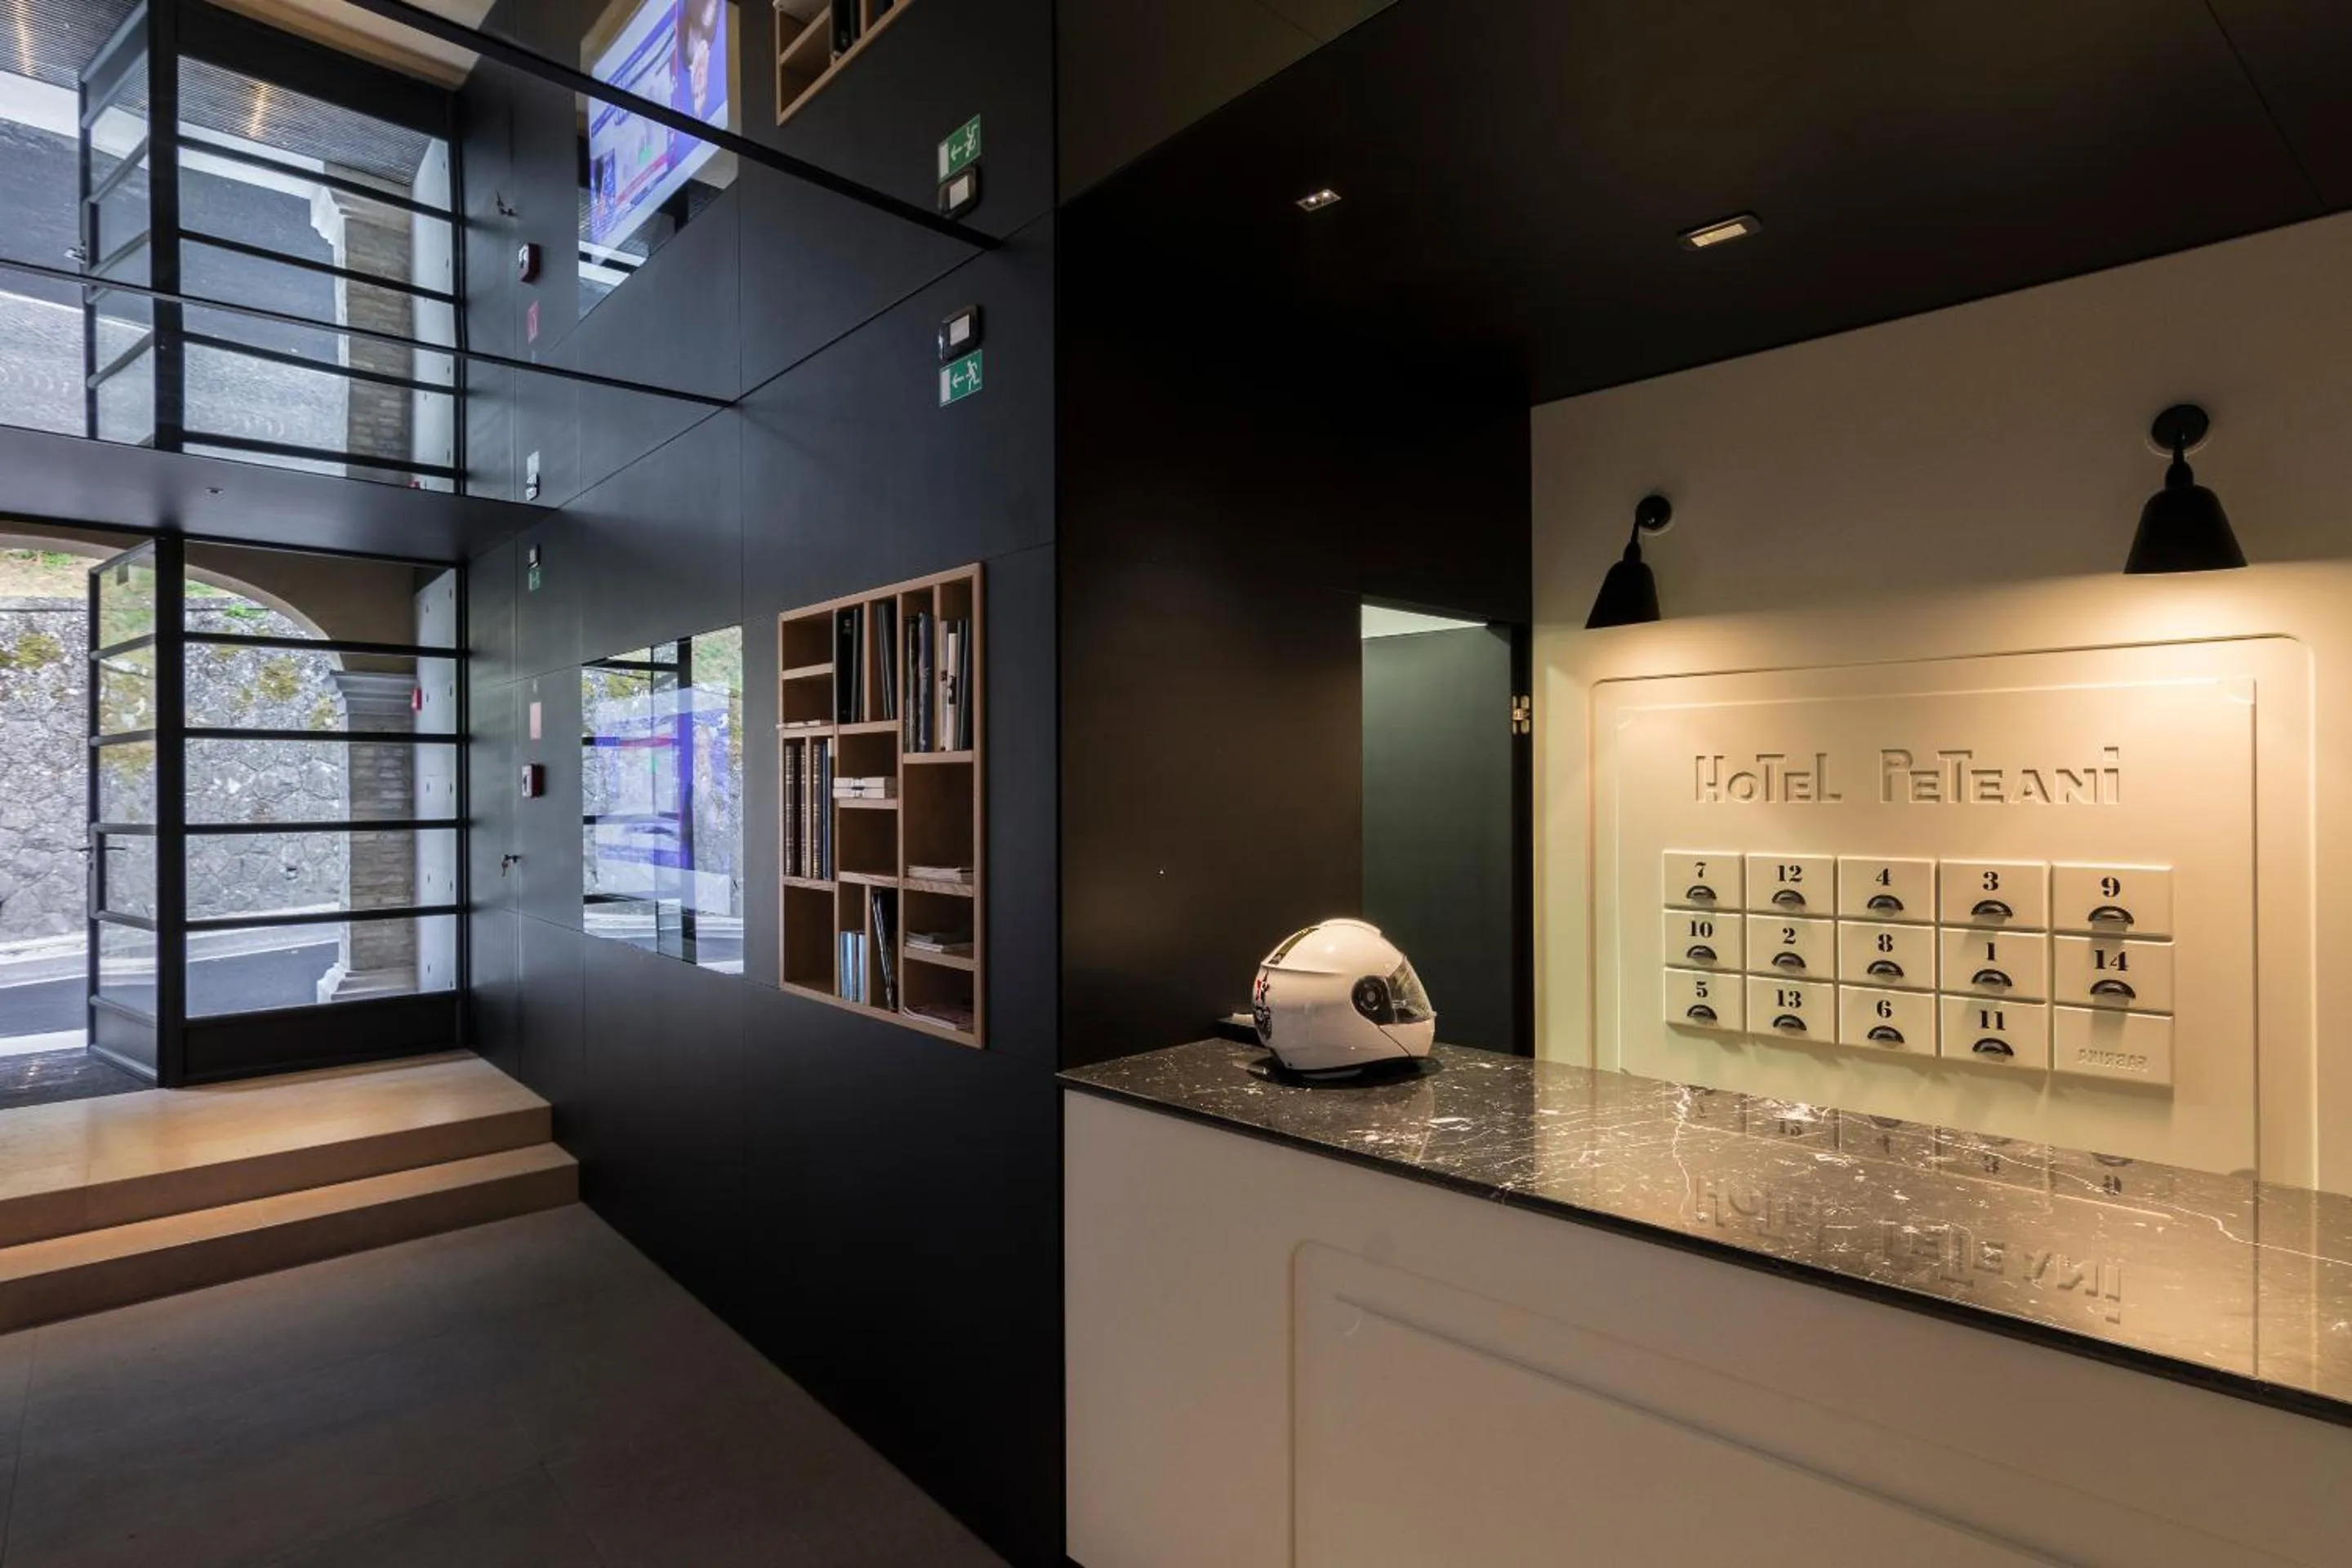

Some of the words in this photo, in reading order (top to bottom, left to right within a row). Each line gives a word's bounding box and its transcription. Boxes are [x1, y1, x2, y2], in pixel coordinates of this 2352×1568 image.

[1695, 862, 1707, 879] 7
[1777, 865, 1802, 883] 12
[1875, 868, 1891, 886] 4
[1983, 871, 1999, 891] 3
[2101, 877, 2121, 898] 9
[1689, 920, 1713, 938] 10
[1782, 927, 1796, 945] 2
[1878, 933, 1893, 952] 8
[1985, 942, 1996, 961] 1
[2093, 948, 2129, 972] 14
[1696, 981, 1708, 998] 5
[1776, 989, 1802, 1009] 13
[1876, 1000, 1892, 1018] 6
[1979, 1009, 2007, 1031] 11
